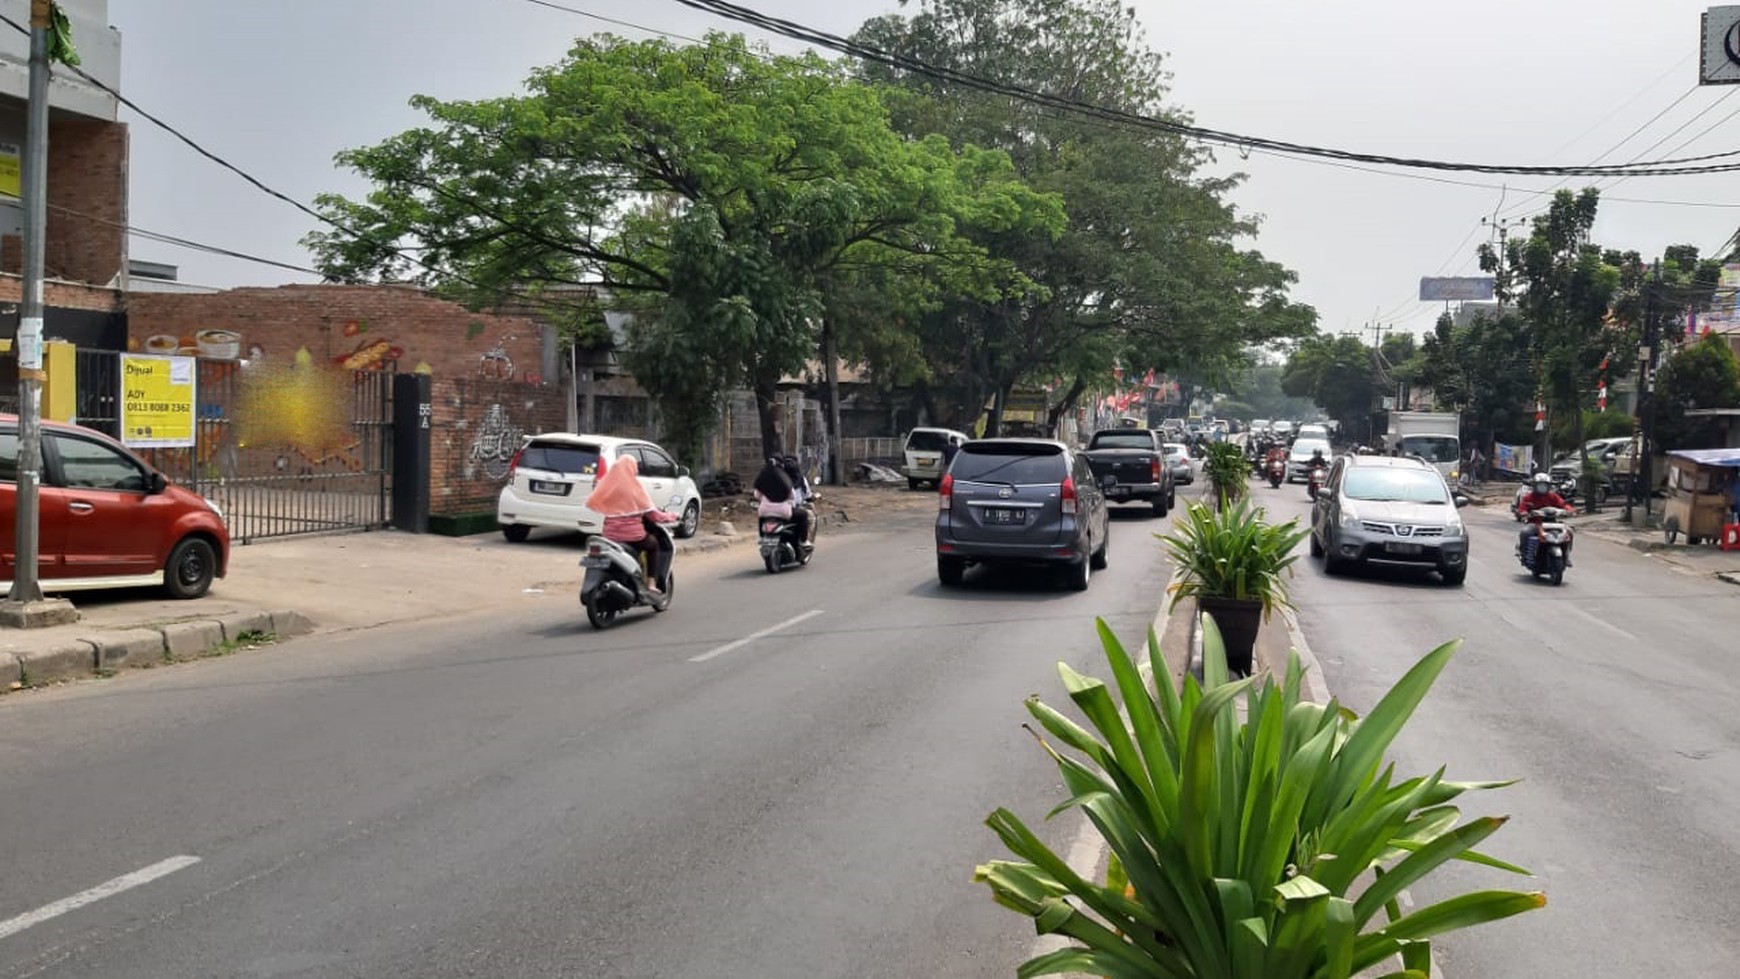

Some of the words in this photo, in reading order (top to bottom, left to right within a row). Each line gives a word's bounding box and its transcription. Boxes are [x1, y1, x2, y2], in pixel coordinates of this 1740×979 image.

[126, 365, 153, 376] Dijual
[127, 390, 145, 399] ADY
[127, 403, 148, 412] 0813
[171, 403, 191, 413] 2362
